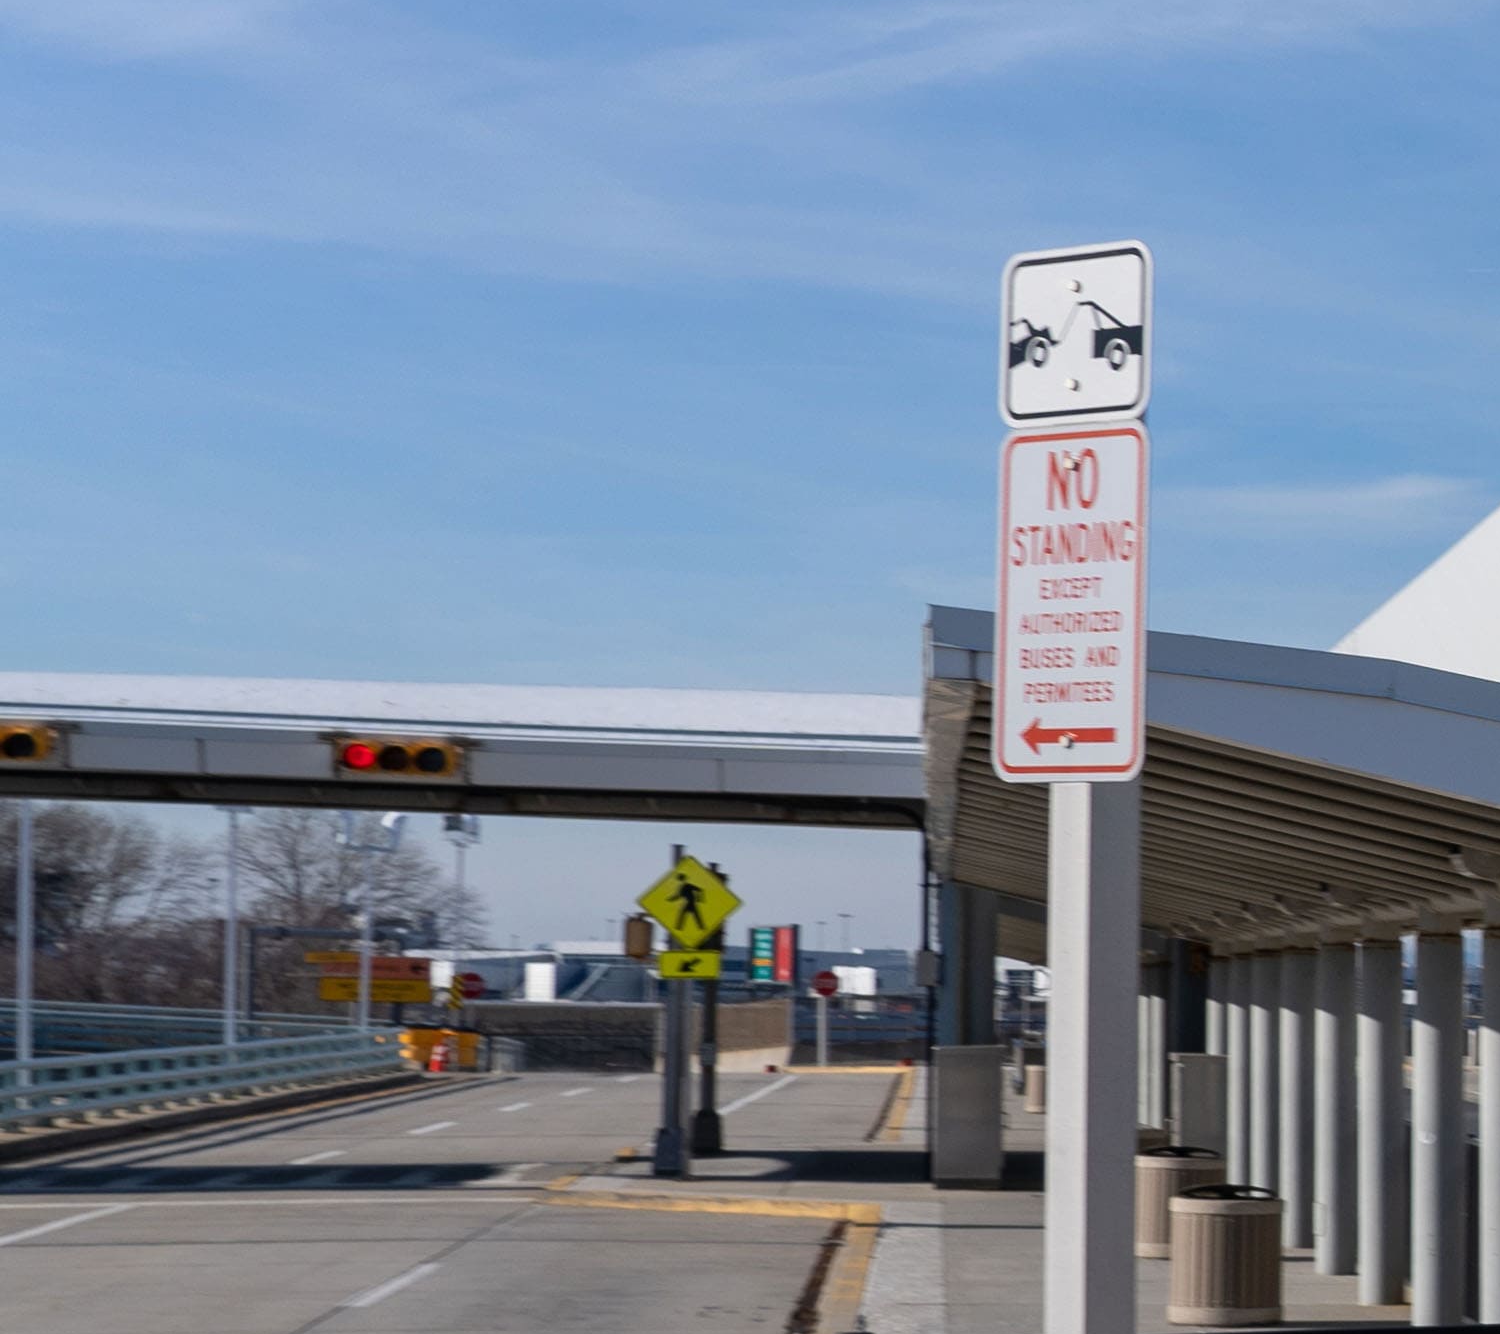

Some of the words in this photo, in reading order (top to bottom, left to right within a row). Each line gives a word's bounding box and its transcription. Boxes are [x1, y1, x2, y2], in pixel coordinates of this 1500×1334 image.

[1047, 448, 1098, 510] NO
[1011, 520, 1135, 566] STANDING
[1039, 576, 1103, 600] EXCEPT
[1018, 610, 1123, 634] AUTHORIZED
[1018, 647, 1075, 669] BUSES
[1084, 645, 1121, 667] AND
